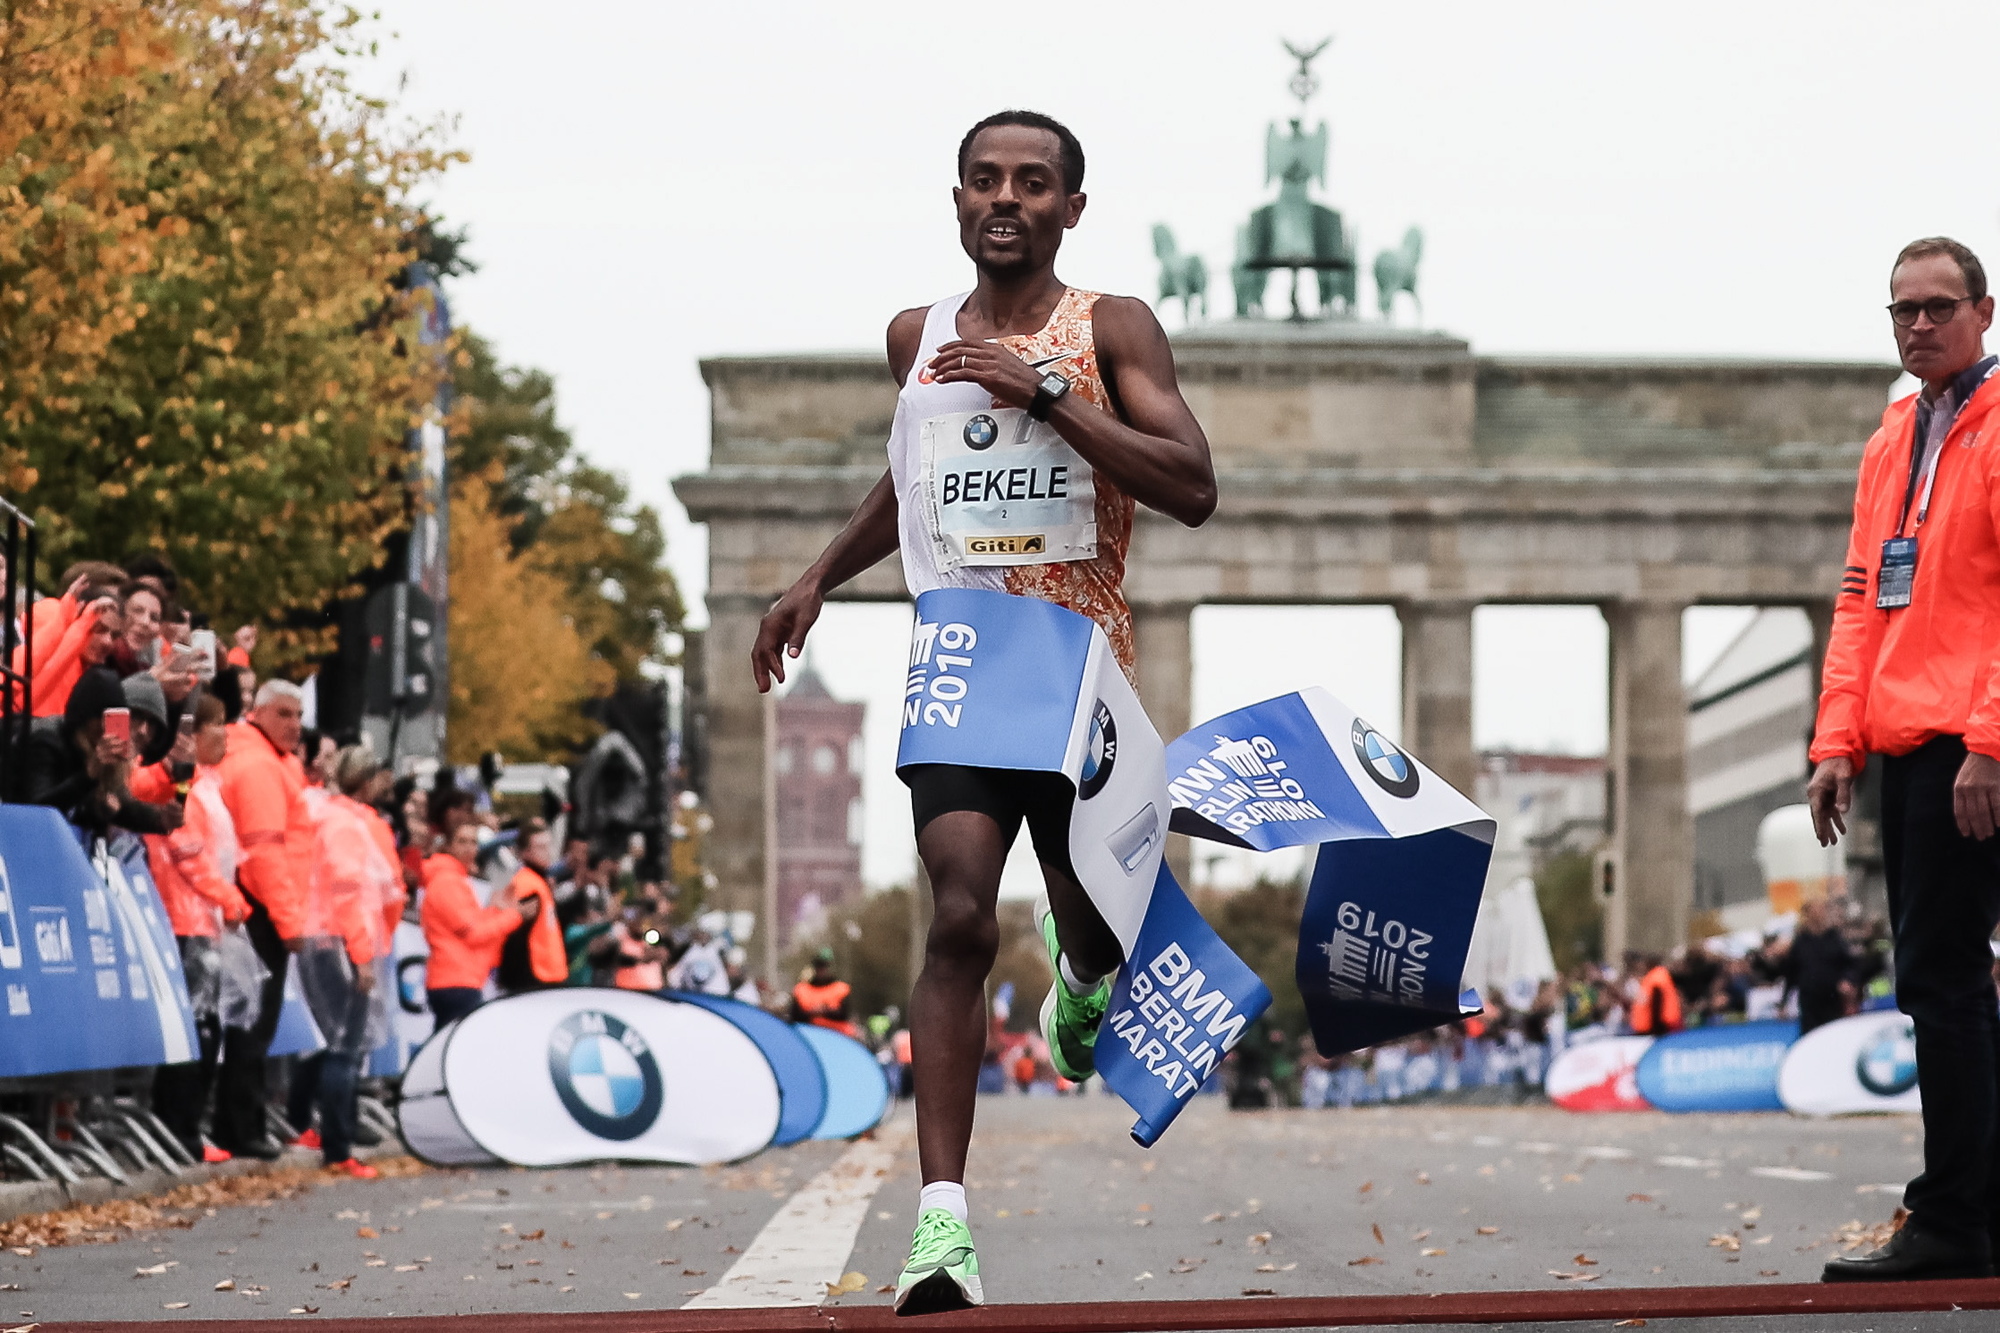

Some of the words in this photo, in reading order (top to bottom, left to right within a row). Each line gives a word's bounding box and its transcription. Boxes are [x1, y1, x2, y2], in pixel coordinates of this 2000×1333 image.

[943, 466, 1068, 506] BEKELE
[1001, 509, 1008, 519] 2
[970, 540, 1016, 553] Giti
[923, 623, 978, 728] 2019
[1167, 758, 1228, 809] MW
[1195, 778, 1257, 823] RLIN
[1225, 799, 1310, 835] RATHON
[1337, 901, 1434, 960] 2019
[1149, 941, 1247, 1053] BMW
[1130, 971, 1221, 1080] BERLIN
[1110, 1008, 1199, 1099] MARAT
